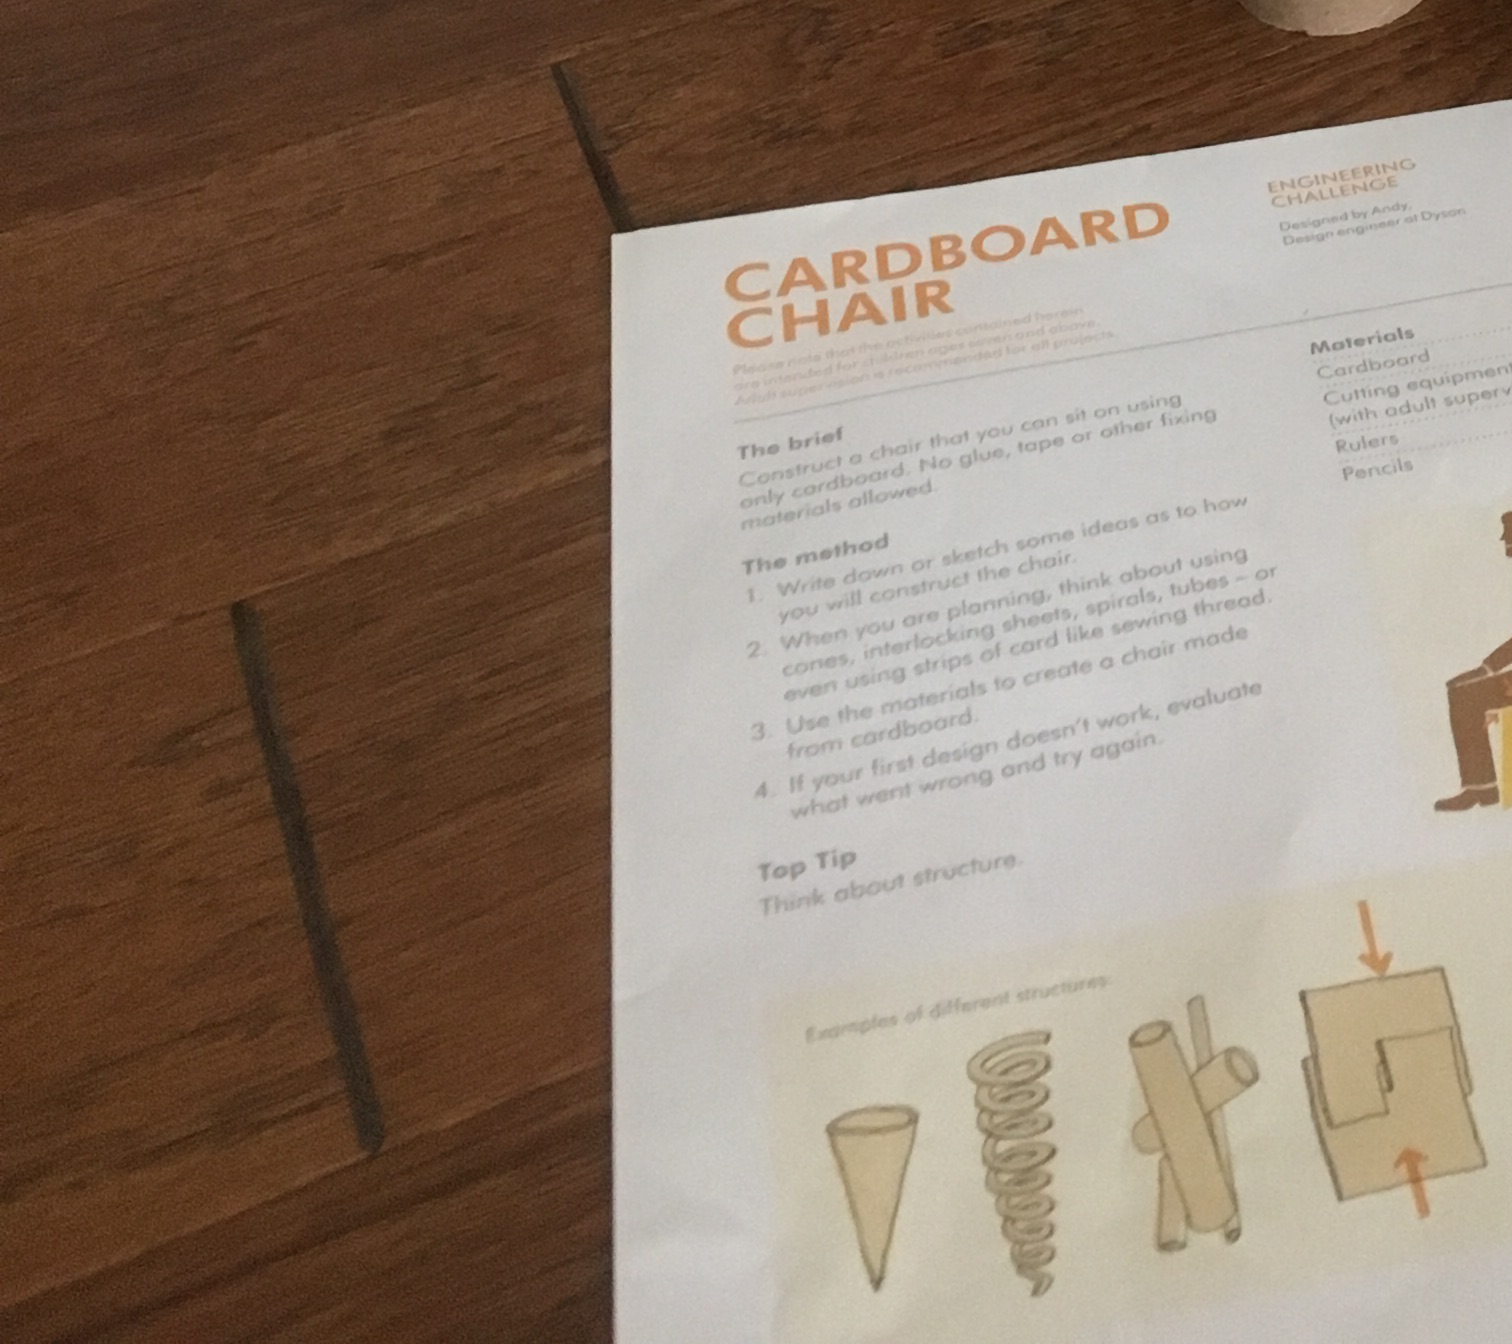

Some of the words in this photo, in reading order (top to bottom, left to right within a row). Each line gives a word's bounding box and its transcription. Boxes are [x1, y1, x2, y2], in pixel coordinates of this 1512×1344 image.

[1267, 158, 1416, 194] ENGINEERING
[1271, 175, 1399, 209] CHALLENGE
[725, 203, 1169, 302] CARDBOARD
[727, 279, 954, 348] CHAIR
[1310, 326, 1414, 356] Materials
[1316, 347, 1430, 380] Cardboard
[1323, 384, 1399, 406] Cutting
[1328, 406, 1377, 431] (with
[1384, 395, 1436, 418] adult
[737, 443, 780, 461] The
[788, 425, 843, 452] brief
[738, 454, 843, 488] Construct
[849, 453, 862, 466] a
[869, 439, 921, 462] chair
[928, 429, 970, 449] that
[976, 424, 1013, 444] you
[1020, 415, 1058, 433] can
[1064, 407, 1088, 425] sit
[1094, 405, 1120, 420] on
[1127, 394, 1182, 415] using
[739, 487, 783, 510] only
[919, 455, 952, 473] No
[1017, 435, 1064, 454] tape
[1071, 430, 1093, 445] or
[1099, 419, 1152, 439] other
[1160, 408, 1217, 428] fixing
[1335, 434, 1399, 454] Rulers
[1341, 456, 1413, 482] Pencils
[740, 498, 841, 531] materials
[741, 556, 787, 576] The
[795, 531, 889, 566] method
[776, 576, 836, 598] Write
[843, 563, 901, 586] down
[911, 557, 936, 574] or
[941, 538, 1008, 567] sketch
[1015, 529, 1073, 552] some
[1081, 516, 1139, 538] ideas
[1145, 509, 1169, 526] as
[1176, 505, 1197, 519] to
[1203, 496, 1248, 514] how
[778, 603, 818, 626] you
[825, 588, 862, 612] will
[869, 570, 969, 604] construct
[976, 565, 1010, 583] the
[779, 627, 847, 652] When
[854, 619, 894, 642] you
[902, 610, 939, 629] are
[1058, 571, 1110, 596] think
[1119, 557, 1183, 585] about
[1190, 548, 1248, 570] using
[863, 623, 994, 661] interlocking
[1170, 575, 1228, 598] tubes
[1254, 565, 1277, 582] or
[783, 679, 837, 703] even
[844, 666, 905, 690] using
[913, 652, 973, 677] strips
[979, 640, 1002, 663] of
[1009, 629, 1058, 657] card
[1065, 624, 1101, 644] like
[1111, 608, 1187, 636] sewing
[786, 714, 829, 735] Use
[836, 704, 874, 724] the
[881, 679, 987, 716] materials
[993, 675, 1015, 692] to
[1023, 659, 1092, 687] create
[1099, 655, 1114, 671] a
[1120, 640, 1175, 666] chair
[1183, 626, 1248, 652] made
[787, 738, 842, 760] from
[788, 772, 805, 794] If
[811, 766, 862, 794] your
[869, 754, 914, 777] first
[921, 740, 997, 769] design
[1166, 682, 1262, 716] evaluate
[790, 793, 848, 820] what
[855, 781, 911, 807] went
[918, 768, 993, 795] wrong
[1000, 751, 1046, 779] and
[1053, 749, 1081, 769] try
[758, 860, 806, 883] Top
[815, 848, 856, 871] Tip
[759, 887, 824, 917] Think
[834, 873, 904, 903] about
